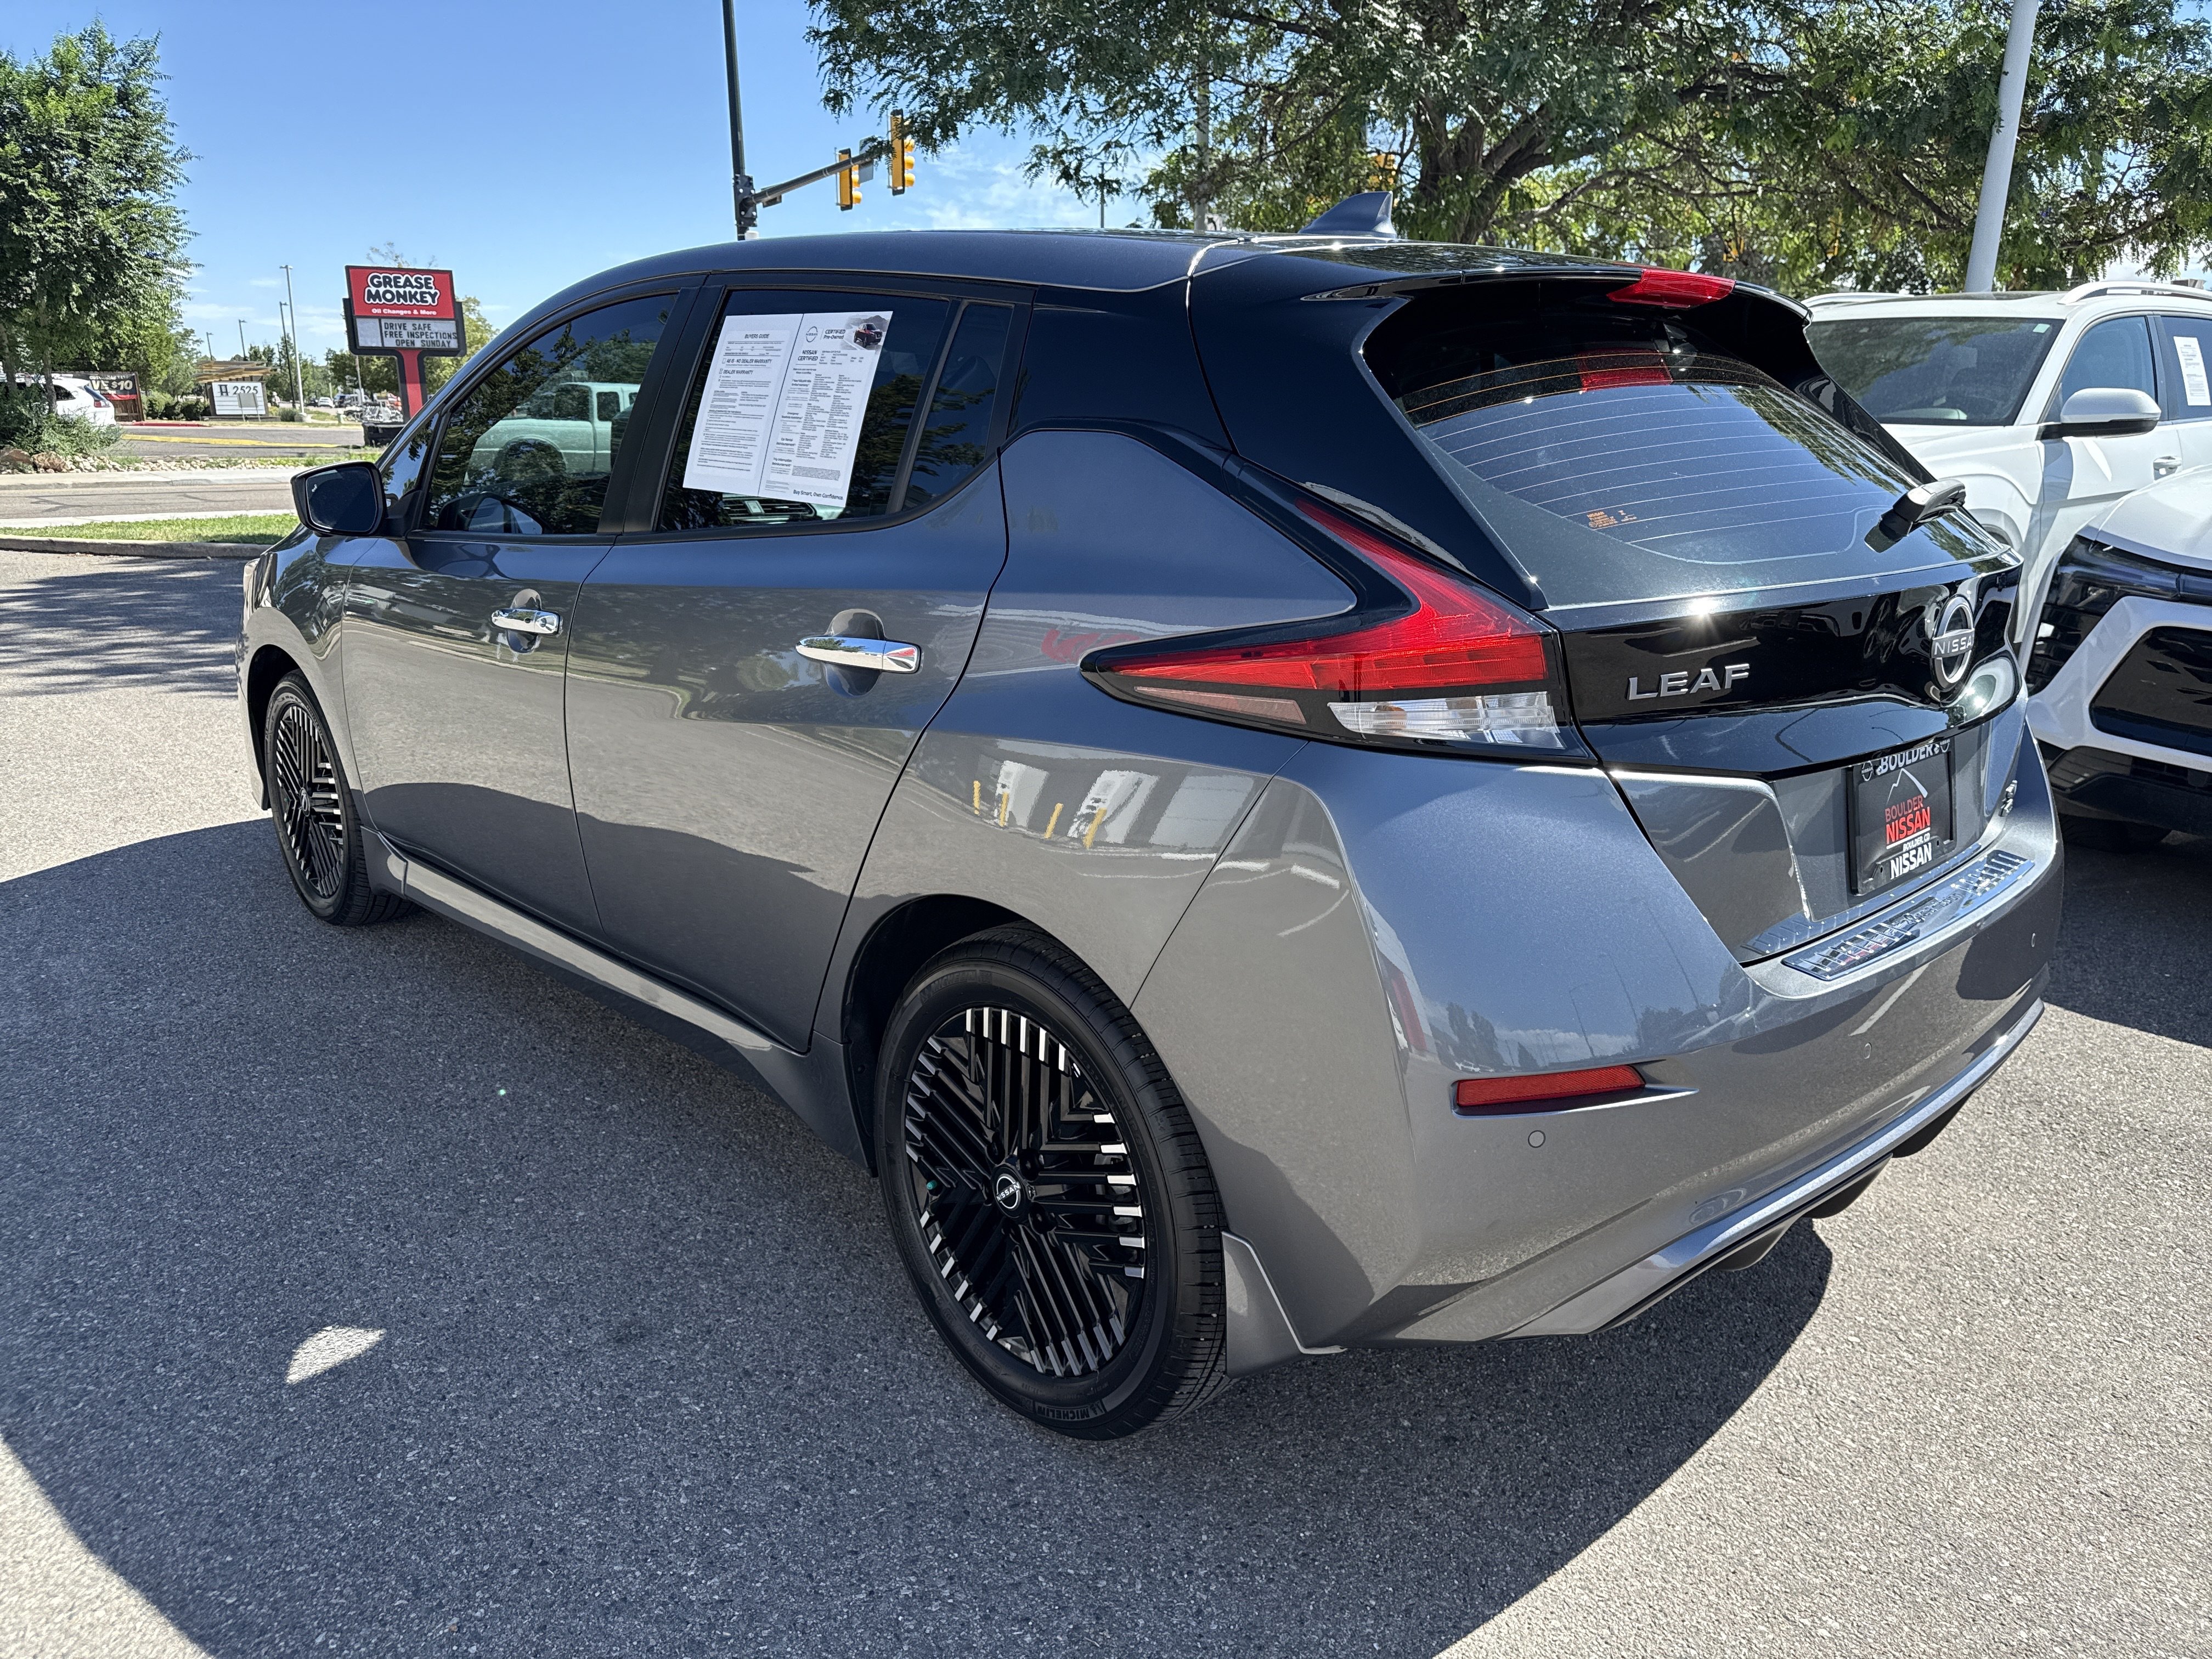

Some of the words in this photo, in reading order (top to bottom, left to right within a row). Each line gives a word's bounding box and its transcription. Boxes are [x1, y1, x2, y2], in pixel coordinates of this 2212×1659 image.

[369, 274, 434, 290] GREASE
[365, 289, 438, 304] MONKEY
[384, 322, 407, 330] DRIVE
[407, 331, 458, 340] INSPECTIONS
[111, 380, 133, 390] $10
[233, 386, 258, 395] 2525
[1627, 663, 1751, 701] LEAF
[1880, 744, 1933, 773] BOULDER
[1884, 795, 1923, 822] BOULDER
[1886, 806, 1931, 844] NISSAN
[1890, 842, 1932, 880] NISSAN
[996, 1182, 1020, 1201] NISSAN
[1037, 1404, 1090, 1420] MICHELIN
